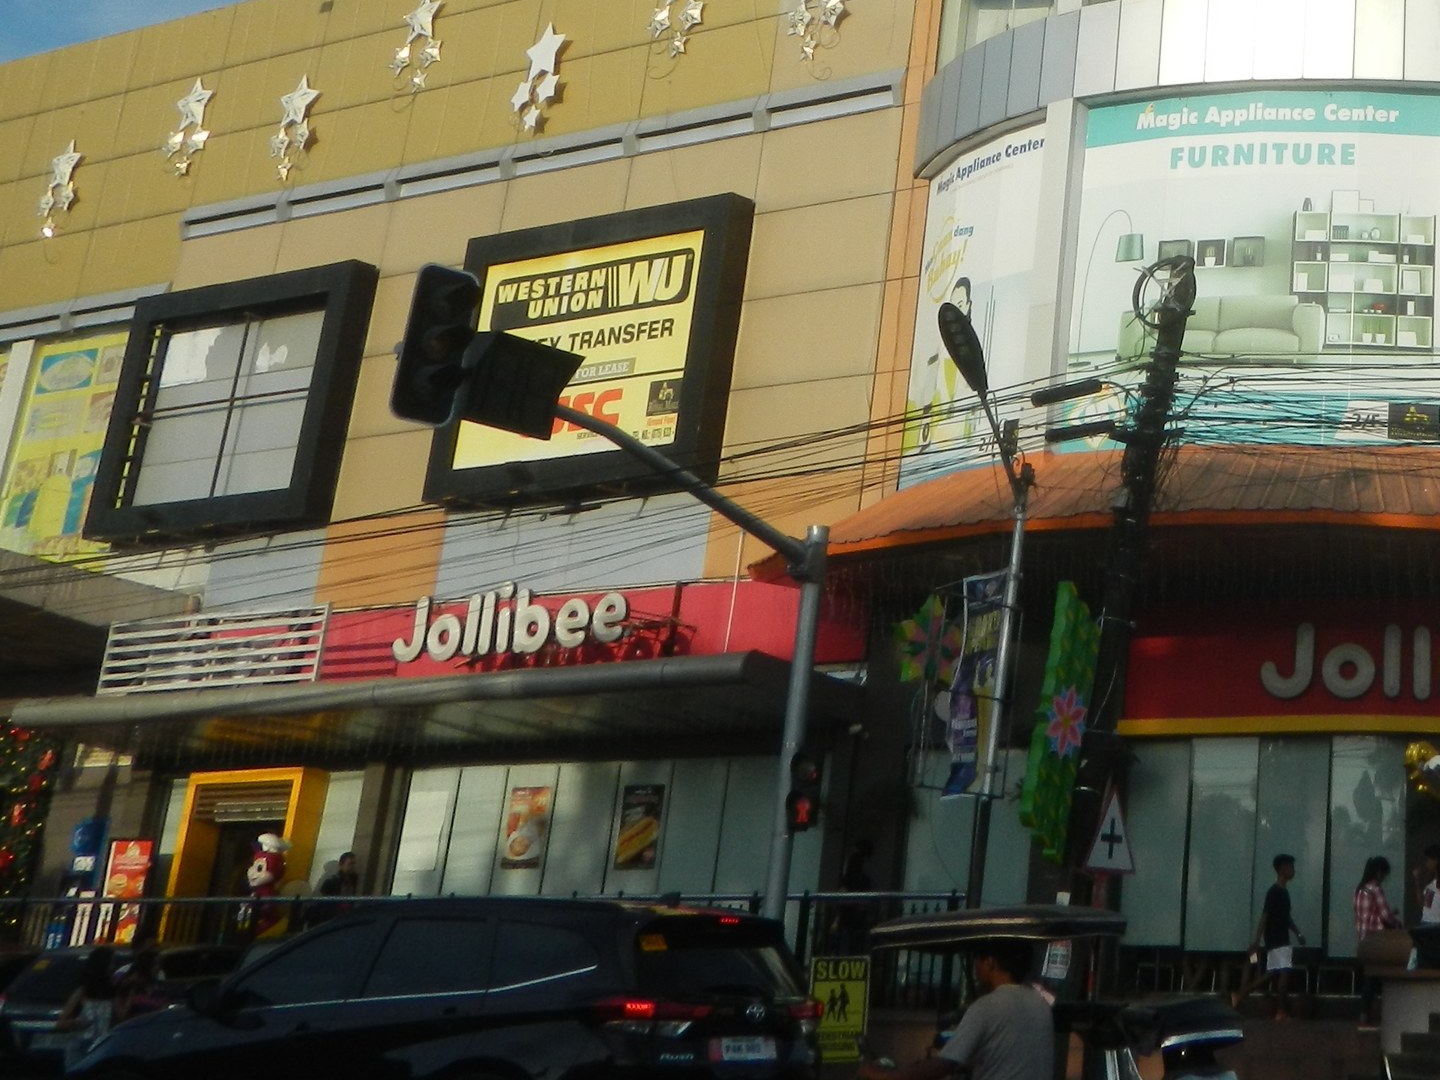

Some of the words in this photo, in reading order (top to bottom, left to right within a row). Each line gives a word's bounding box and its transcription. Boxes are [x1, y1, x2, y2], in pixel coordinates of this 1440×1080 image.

[1136, 105, 1198, 130] Magic
[1205, 103, 1316, 128] Appliance
[1324, 103, 1400, 123] Center
[937, 172, 956, 196] Magic
[955, 152, 1002, 182] Appliance
[1005, 138, 1046, 158] Center
[1169, 142, 1356, 170] FURNITURE
[498, 267, 608, 305] WESTERN
[618, 254, 688, 307] WU
[527, 289, 604, 320] UNION
[568, 318, 675, 352] TRANSFER
[575, 365, 599, 379] FOR
[599, 361, 630, 375] LEASE
[391, 580, 627, 663] Jollibee
[816, 960, 866, 980] SLOW
